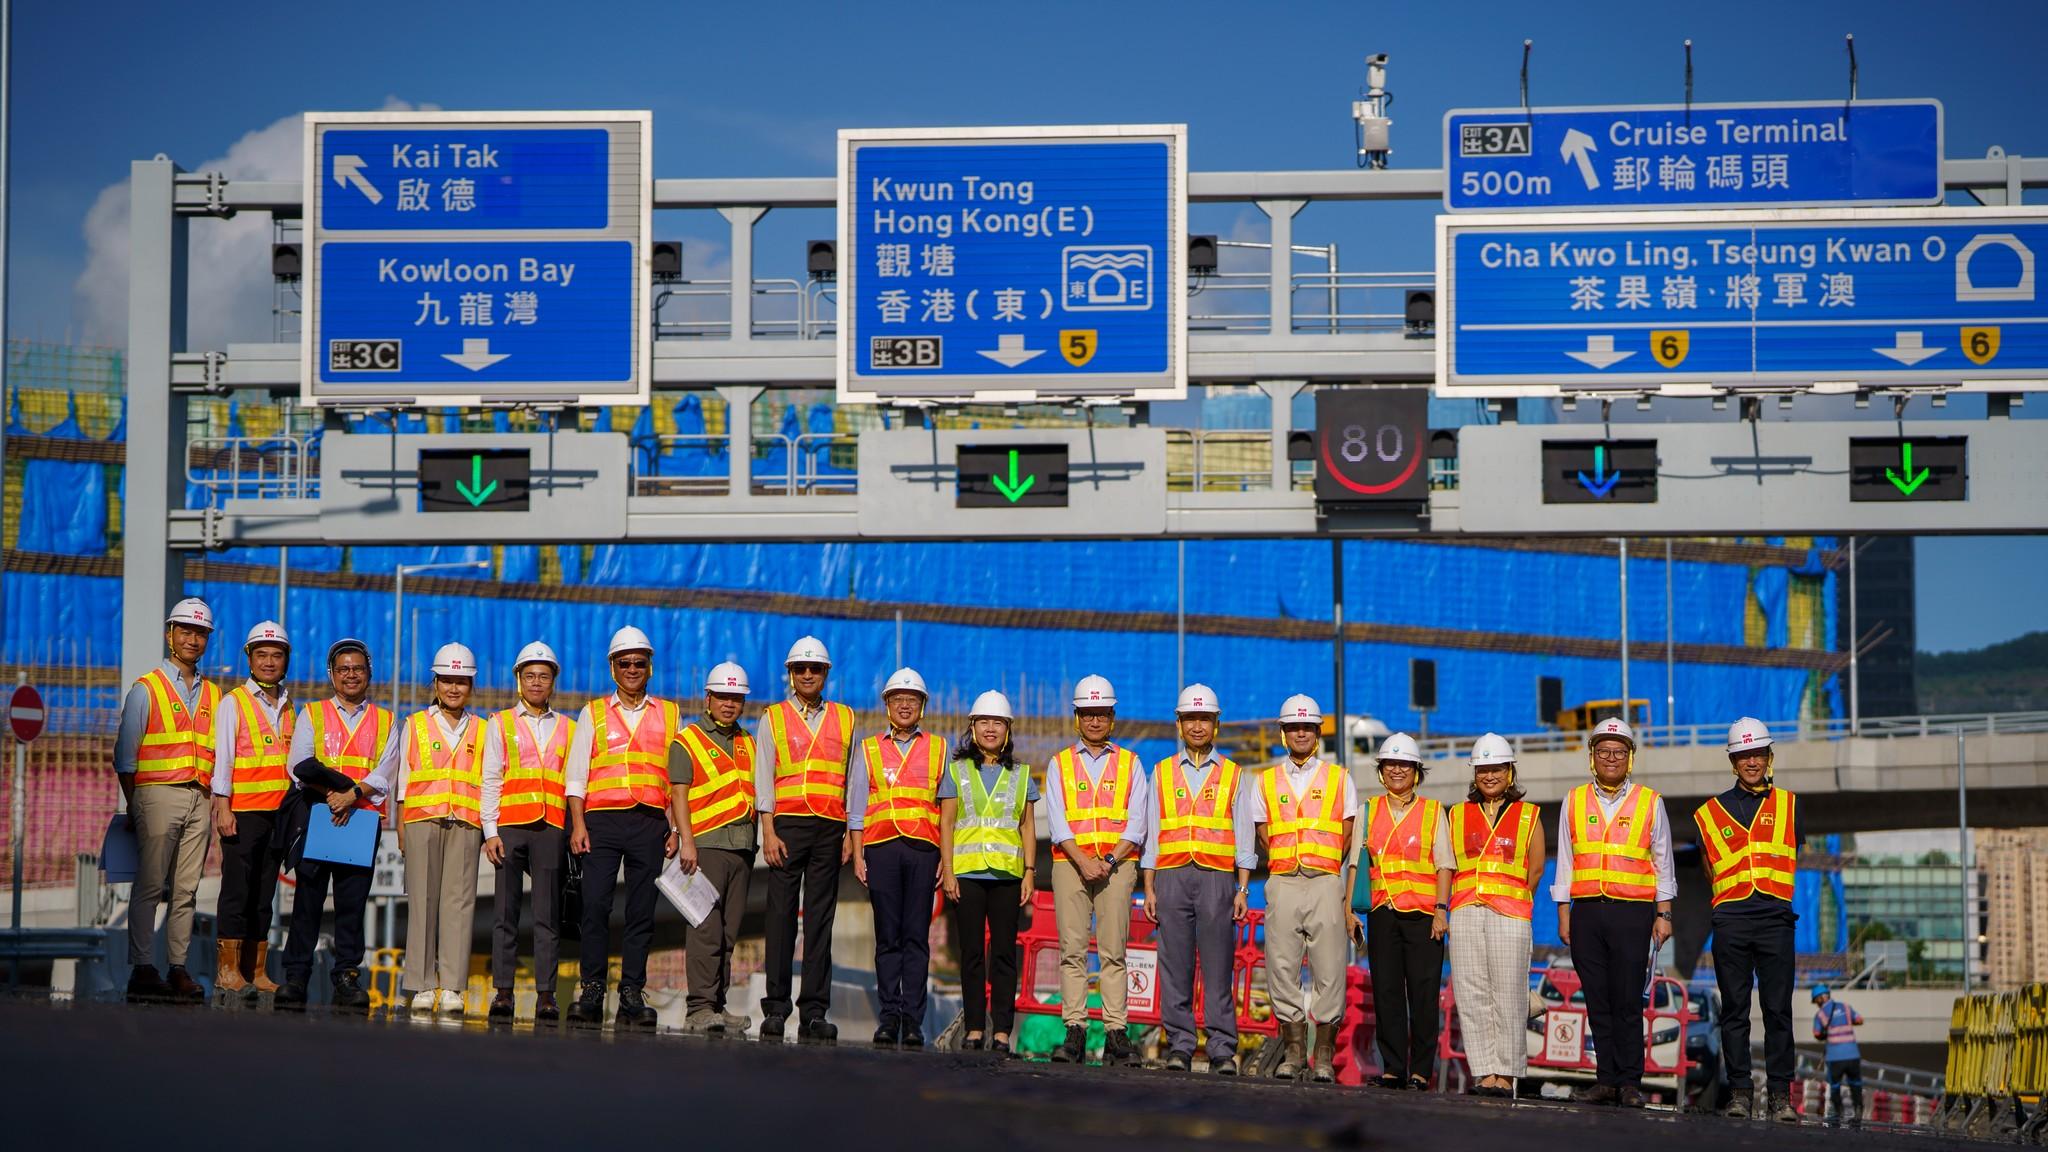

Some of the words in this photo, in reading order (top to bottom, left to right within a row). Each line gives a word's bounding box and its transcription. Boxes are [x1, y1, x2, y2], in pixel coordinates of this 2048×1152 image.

[1464, 128, 1481, 137] EXIT
[1485, 128, 1526, 152] 3A
[1610, 122, 1706, 145] Cruise
[1717, 118, 1846, 143] Terminal
[394, 145, 438, 167] Kai
[449, 144, 497, 167] Tak
[1463, 138, 1482, 153] 出
[1463, 171, 1550, 195] 500m
[1613, 155, 1788, 191] 郵輪碼頭
[873, 178, 952, 201] Kwun
[963, 176, 1032, 204] Tong
[875, 210, 951, 238] Hong
[963, 206, 1093, 236] Kong(E)
[877, 244, 954, 276] 觀塘
[1481, 243, 1539, 268] Cha
[1551, 242, 1616, 266] Kwo
[1627, 241, 1697, 270] Ling,
[1707, 239, 1815, 268] Tseung
[1827, 238, 1910, 262] Kwan
[1923, 237, 1945, 261] O
[380, 259, 507, 281] Kowloon
[520, 258, 574, 286] Bay
[1070, 281, 1085, 297] 東
[1131, 280, 1143, 298] E
[416, 292, 537, 325] 九龍灣
[354, 343, 395, 367] 3C
[874, 340, 891, 349] EXIT
[895, 340, 938, 365] 3B
[1070, 336, 1088, 359] 5
[1660, 336, 1679, 360] 6
[1971, 332, 1990, 357] 6
[333, 354, 351, 367] 出
[874, 351, 892, 365] 出
[1341, 425, 1403, 462] 80
